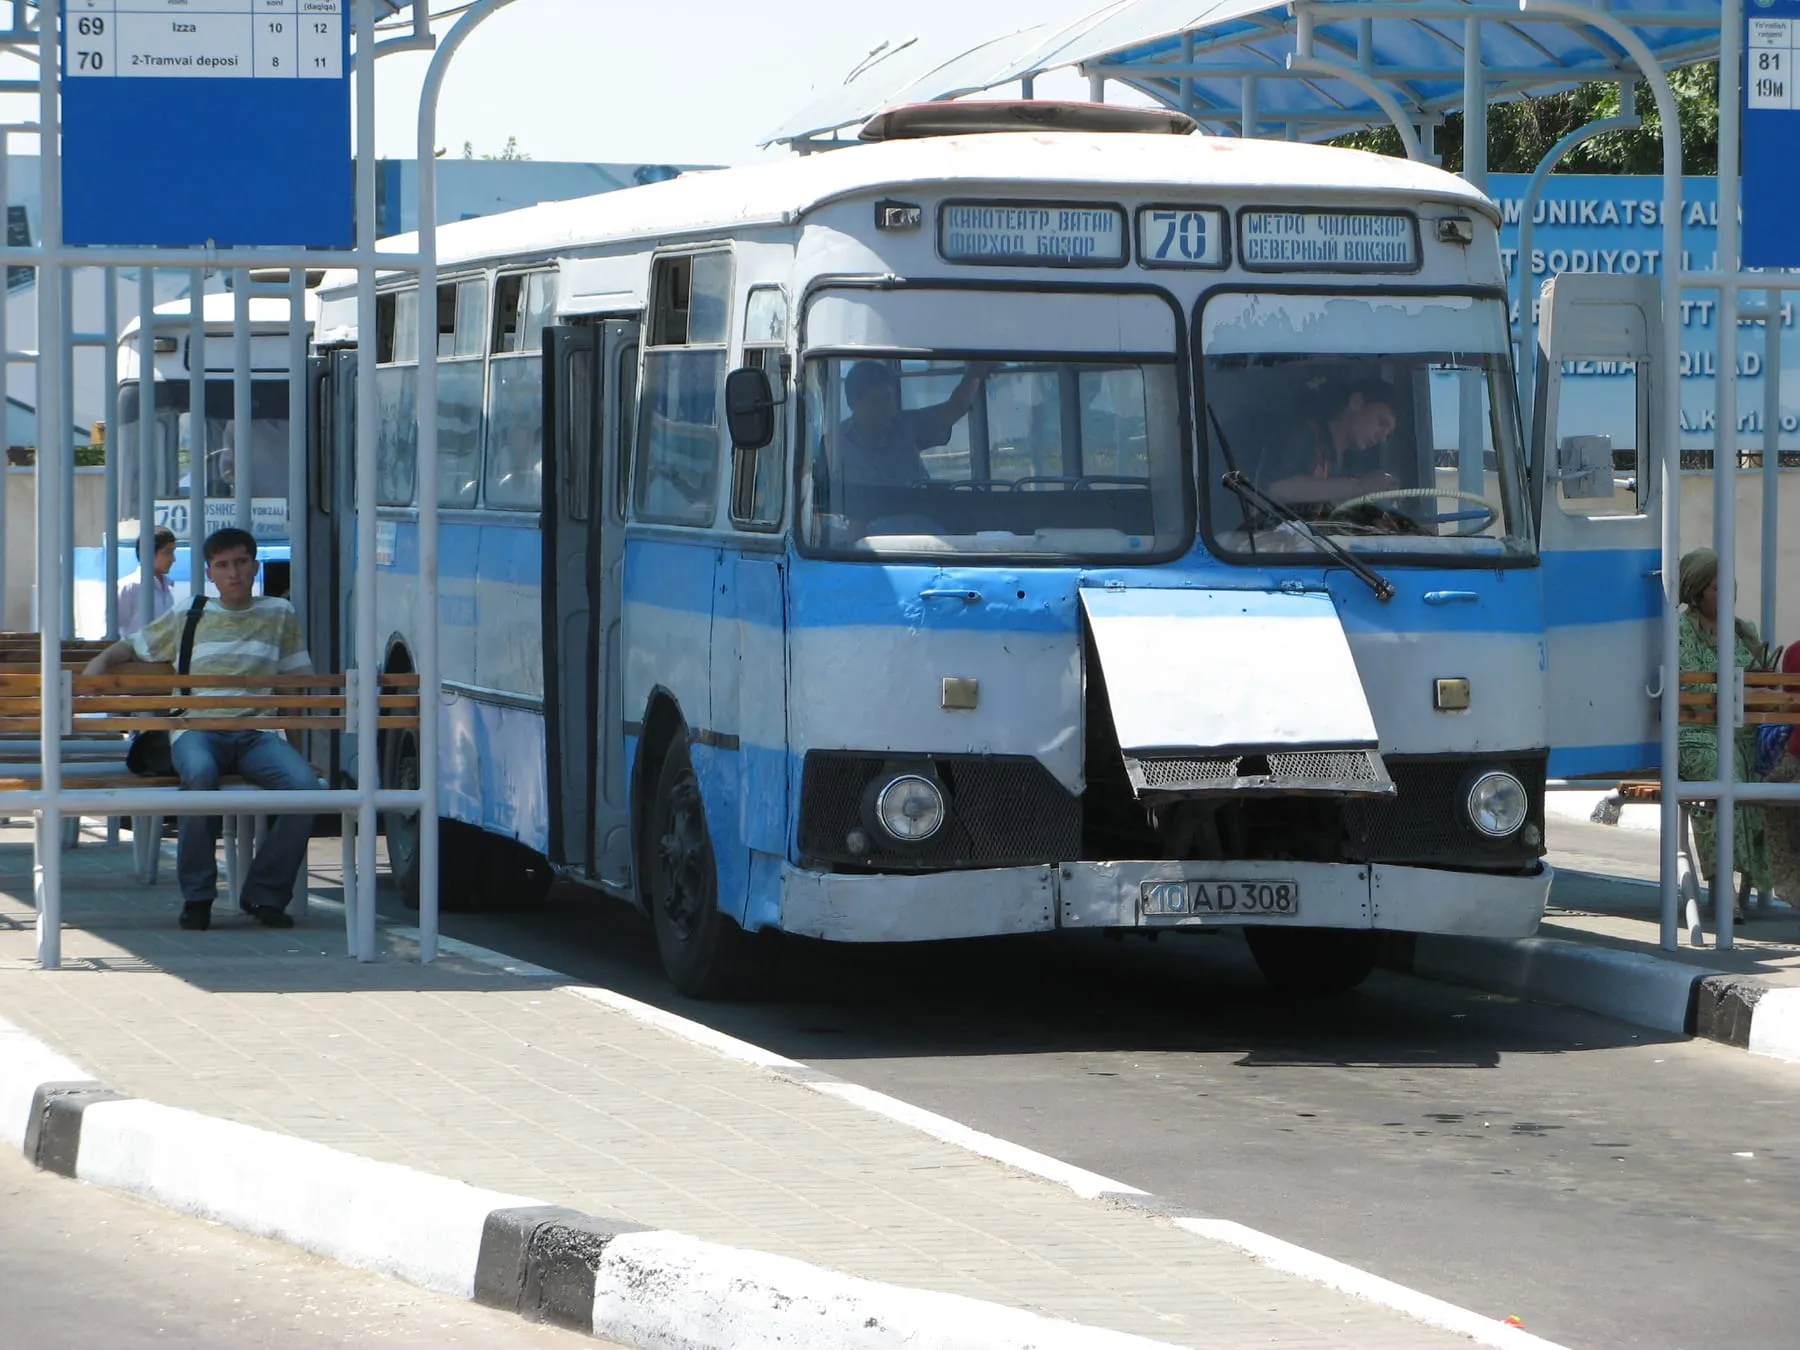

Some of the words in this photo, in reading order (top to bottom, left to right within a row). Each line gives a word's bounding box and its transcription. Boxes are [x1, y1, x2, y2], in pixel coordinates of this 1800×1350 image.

[78, 17, 104, 36] 69
[172, 21, 197, 33] Izza
[268, 23, 283, 33] 10
[313, 23, 328, 34] 12
[77, 51, 103, 70] 70
[131, 54, 193, 66] 2-Tramvai
[196, 55, 239, 69] deposi
[271, 57, 280, 68] 8
[314, 57, 327, 68] 11
[1758, 53, 1780, 71] 81
[949, 208, 1050, 230] КИНОТЕАТР
[1058, 211, 1113, 233] ВАТАН
[1248, 214, 1305, 235] МЕТРО
[949, 231, 1026, 254] ФАРХОД
[1152, 211, 1206, 259] 70
[1248, 237, 1338, 262] СЕВЕРНЫЙ
[1344, 239, 1407, 262] ВОКЗАЛ
[154, 504, 188, 533] 70
[1150, 884, 1185, 912] 10
